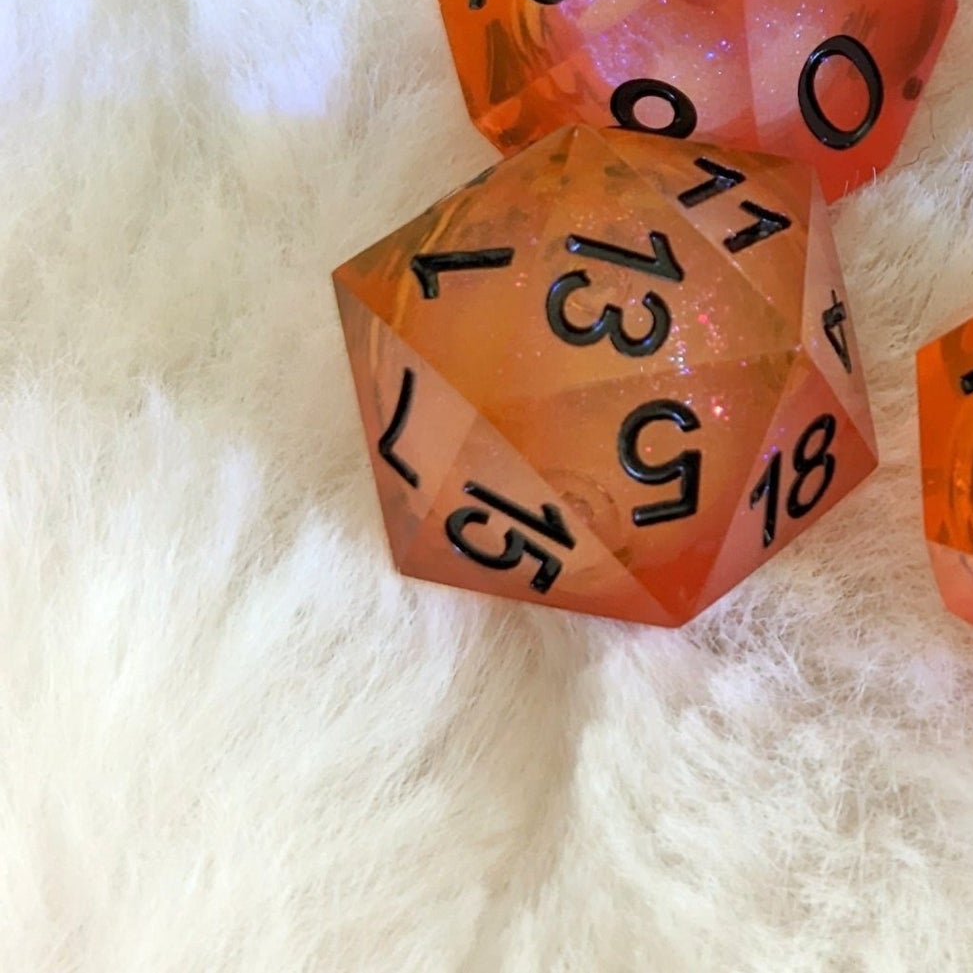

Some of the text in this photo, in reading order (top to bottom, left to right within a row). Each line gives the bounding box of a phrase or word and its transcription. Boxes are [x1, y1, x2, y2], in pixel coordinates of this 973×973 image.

[798, 35, 883, 150] 0
[678, 157, 792, 254] 11
[411, 247, 515, 299] 1
[546, 231, 684, 357] 13
[823, 290, 852, 374] 4
[379, 367, 420, 489] 7
[618, 399, 702, 527] 5
[749, 413, 836, 548] 18
[445, 481, 576, 594] 15
